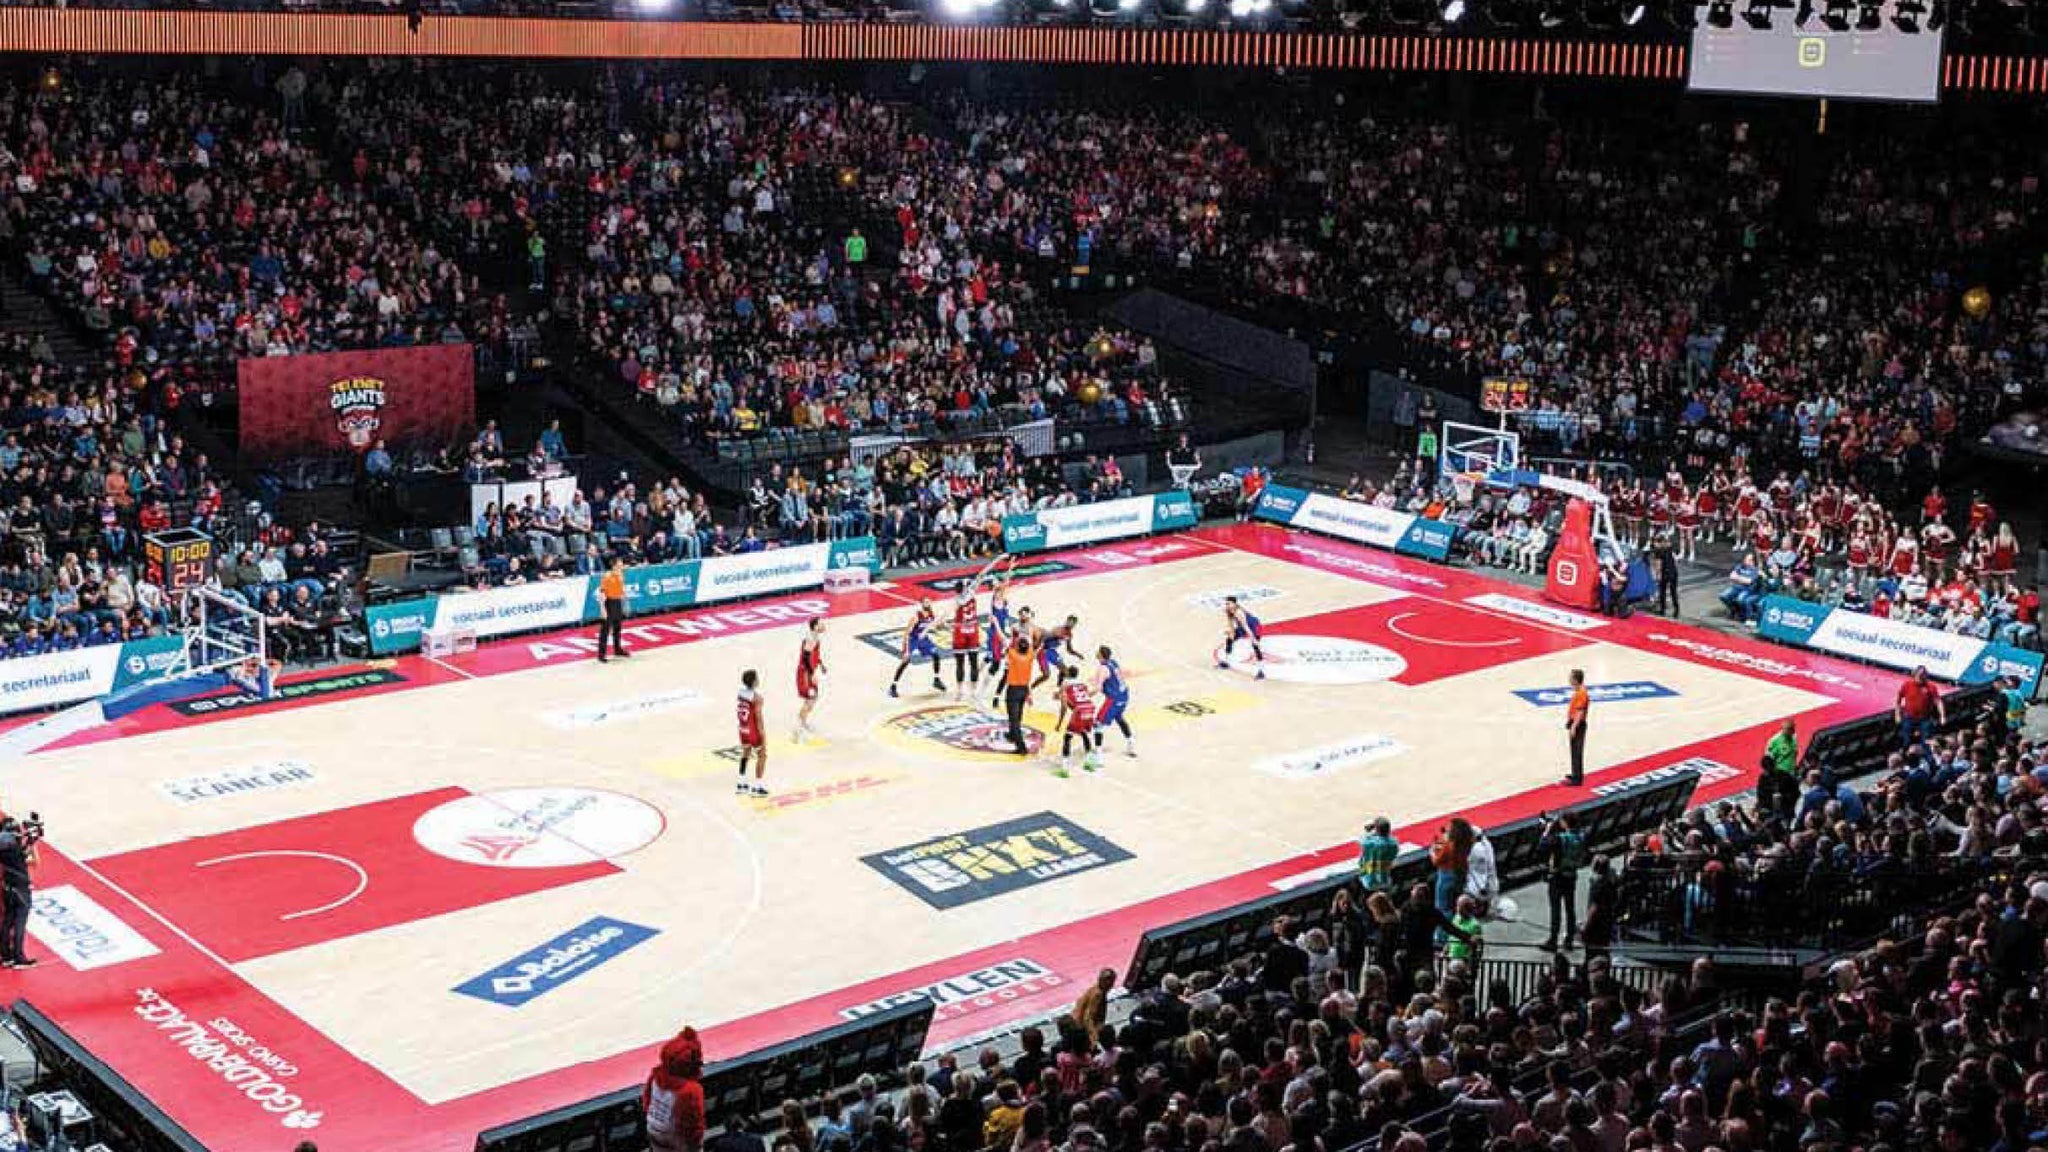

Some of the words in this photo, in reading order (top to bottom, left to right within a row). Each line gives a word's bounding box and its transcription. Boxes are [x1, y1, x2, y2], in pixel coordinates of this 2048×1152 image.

[331, 389, 384, 408] GIANTS
[171, 542, 210, 562] 10:00
[174, 561, 204, 587] 24
[1834, 626, 1879, 645] sociaal
[1879, 633, 1952, 662] secretariaat
[2, 667, 92, 693] secretariaat
